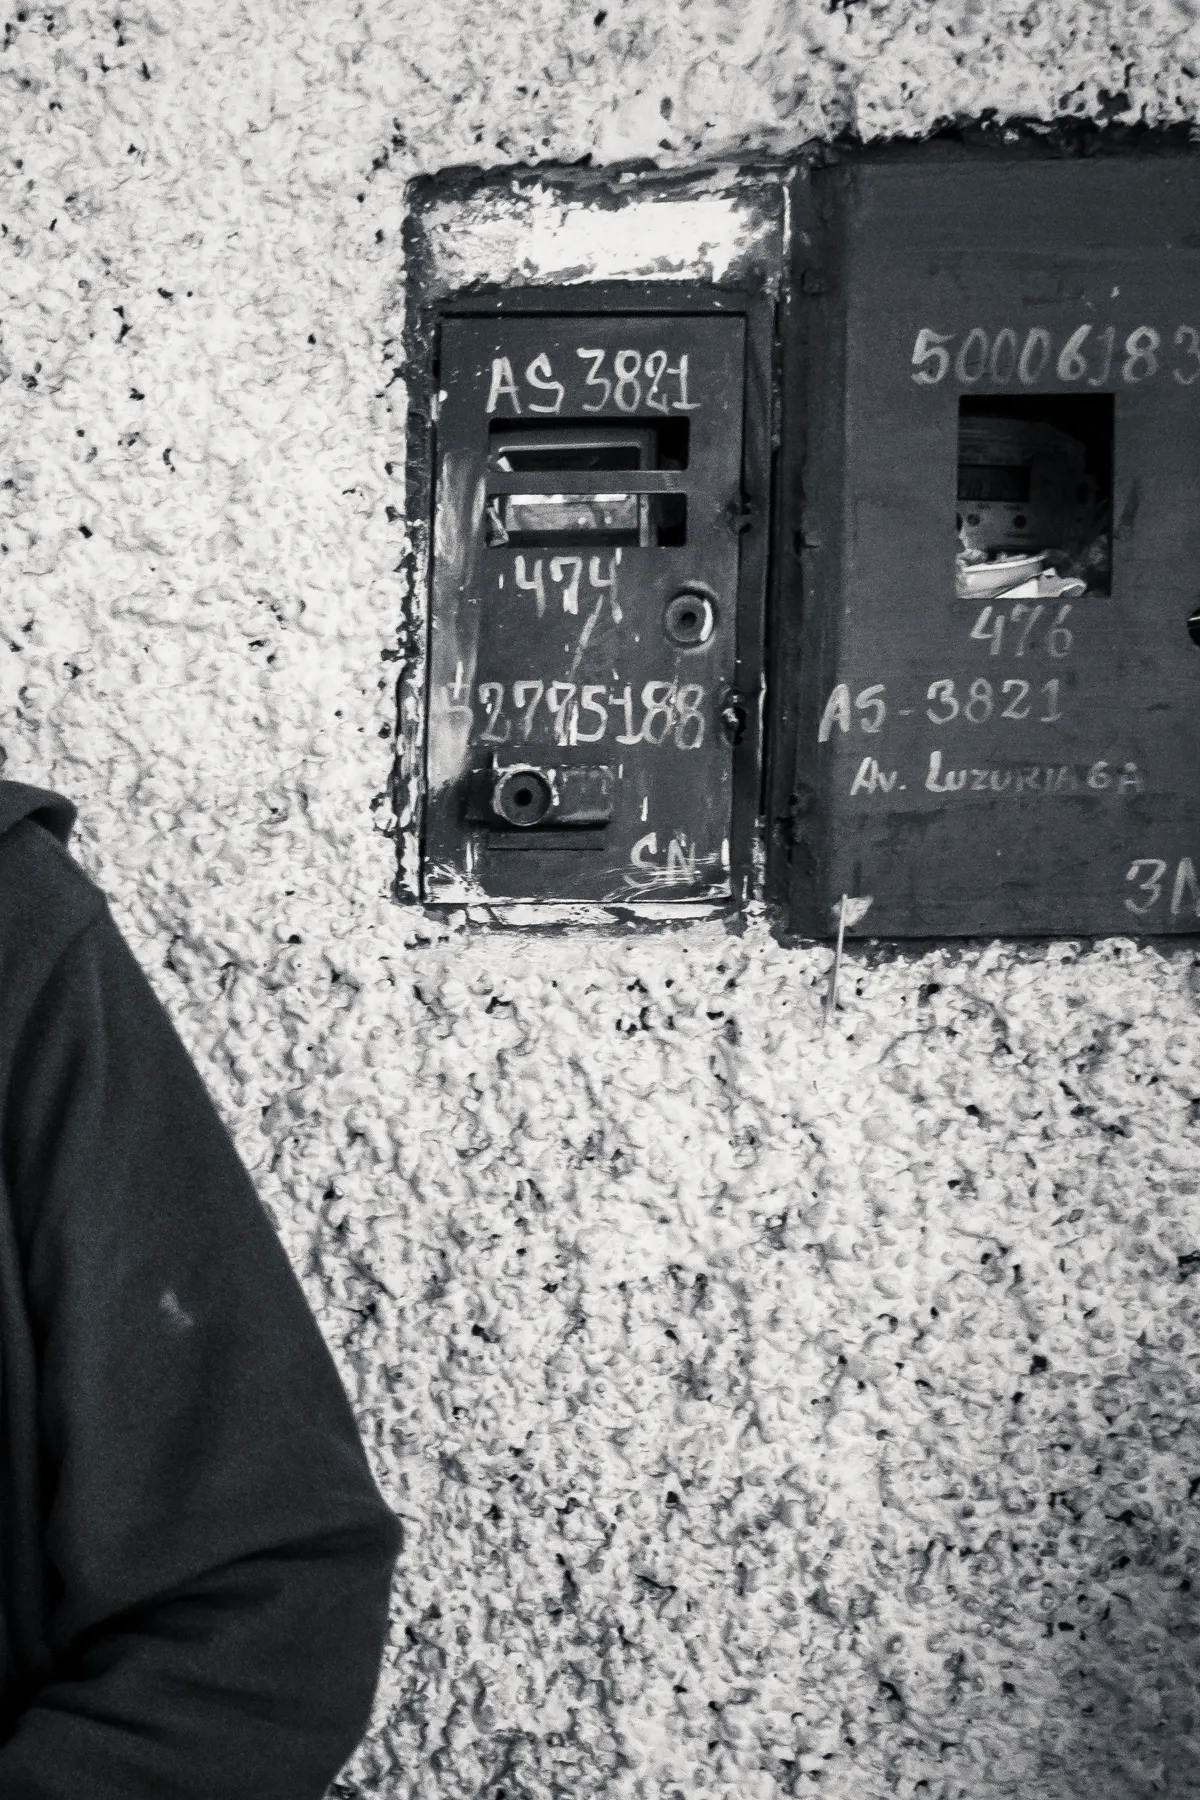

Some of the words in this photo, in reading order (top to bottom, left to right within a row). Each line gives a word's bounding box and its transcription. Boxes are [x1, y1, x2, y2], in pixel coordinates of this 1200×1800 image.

[486, 353, 564, 414] AS
[576, 348, 700, 414] 3821
[515, 555, 624, 624] 474
[970, 604, 1073, 658] 476
